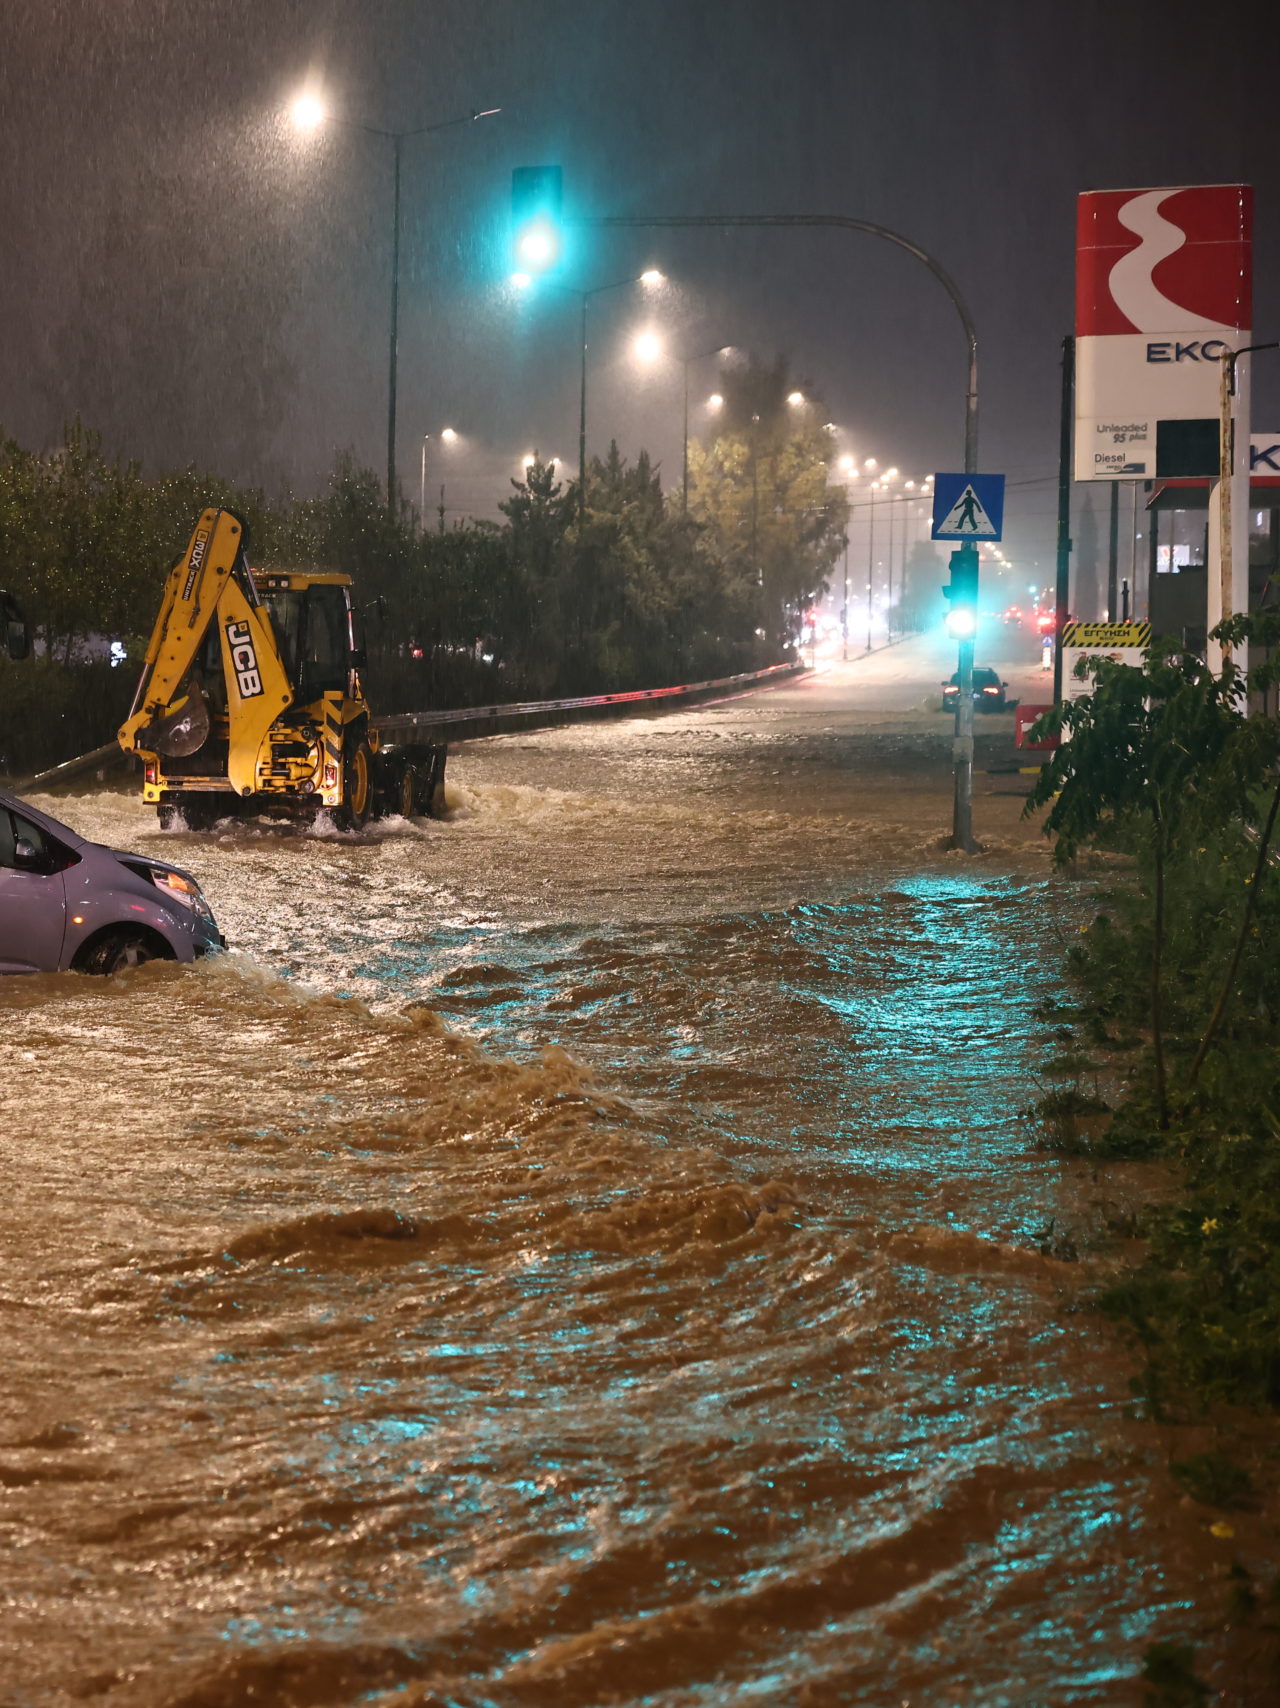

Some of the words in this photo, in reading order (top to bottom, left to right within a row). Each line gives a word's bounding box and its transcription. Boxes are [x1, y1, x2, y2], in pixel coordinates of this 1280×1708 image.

[1113, 433, 1126, 443] 95
[1095, 453, 1126, 463] Diesel
[1084, 629, 1130, 637] ΕΓΓΥΗΣΗ
[228, 624, 262, 698] JCB
